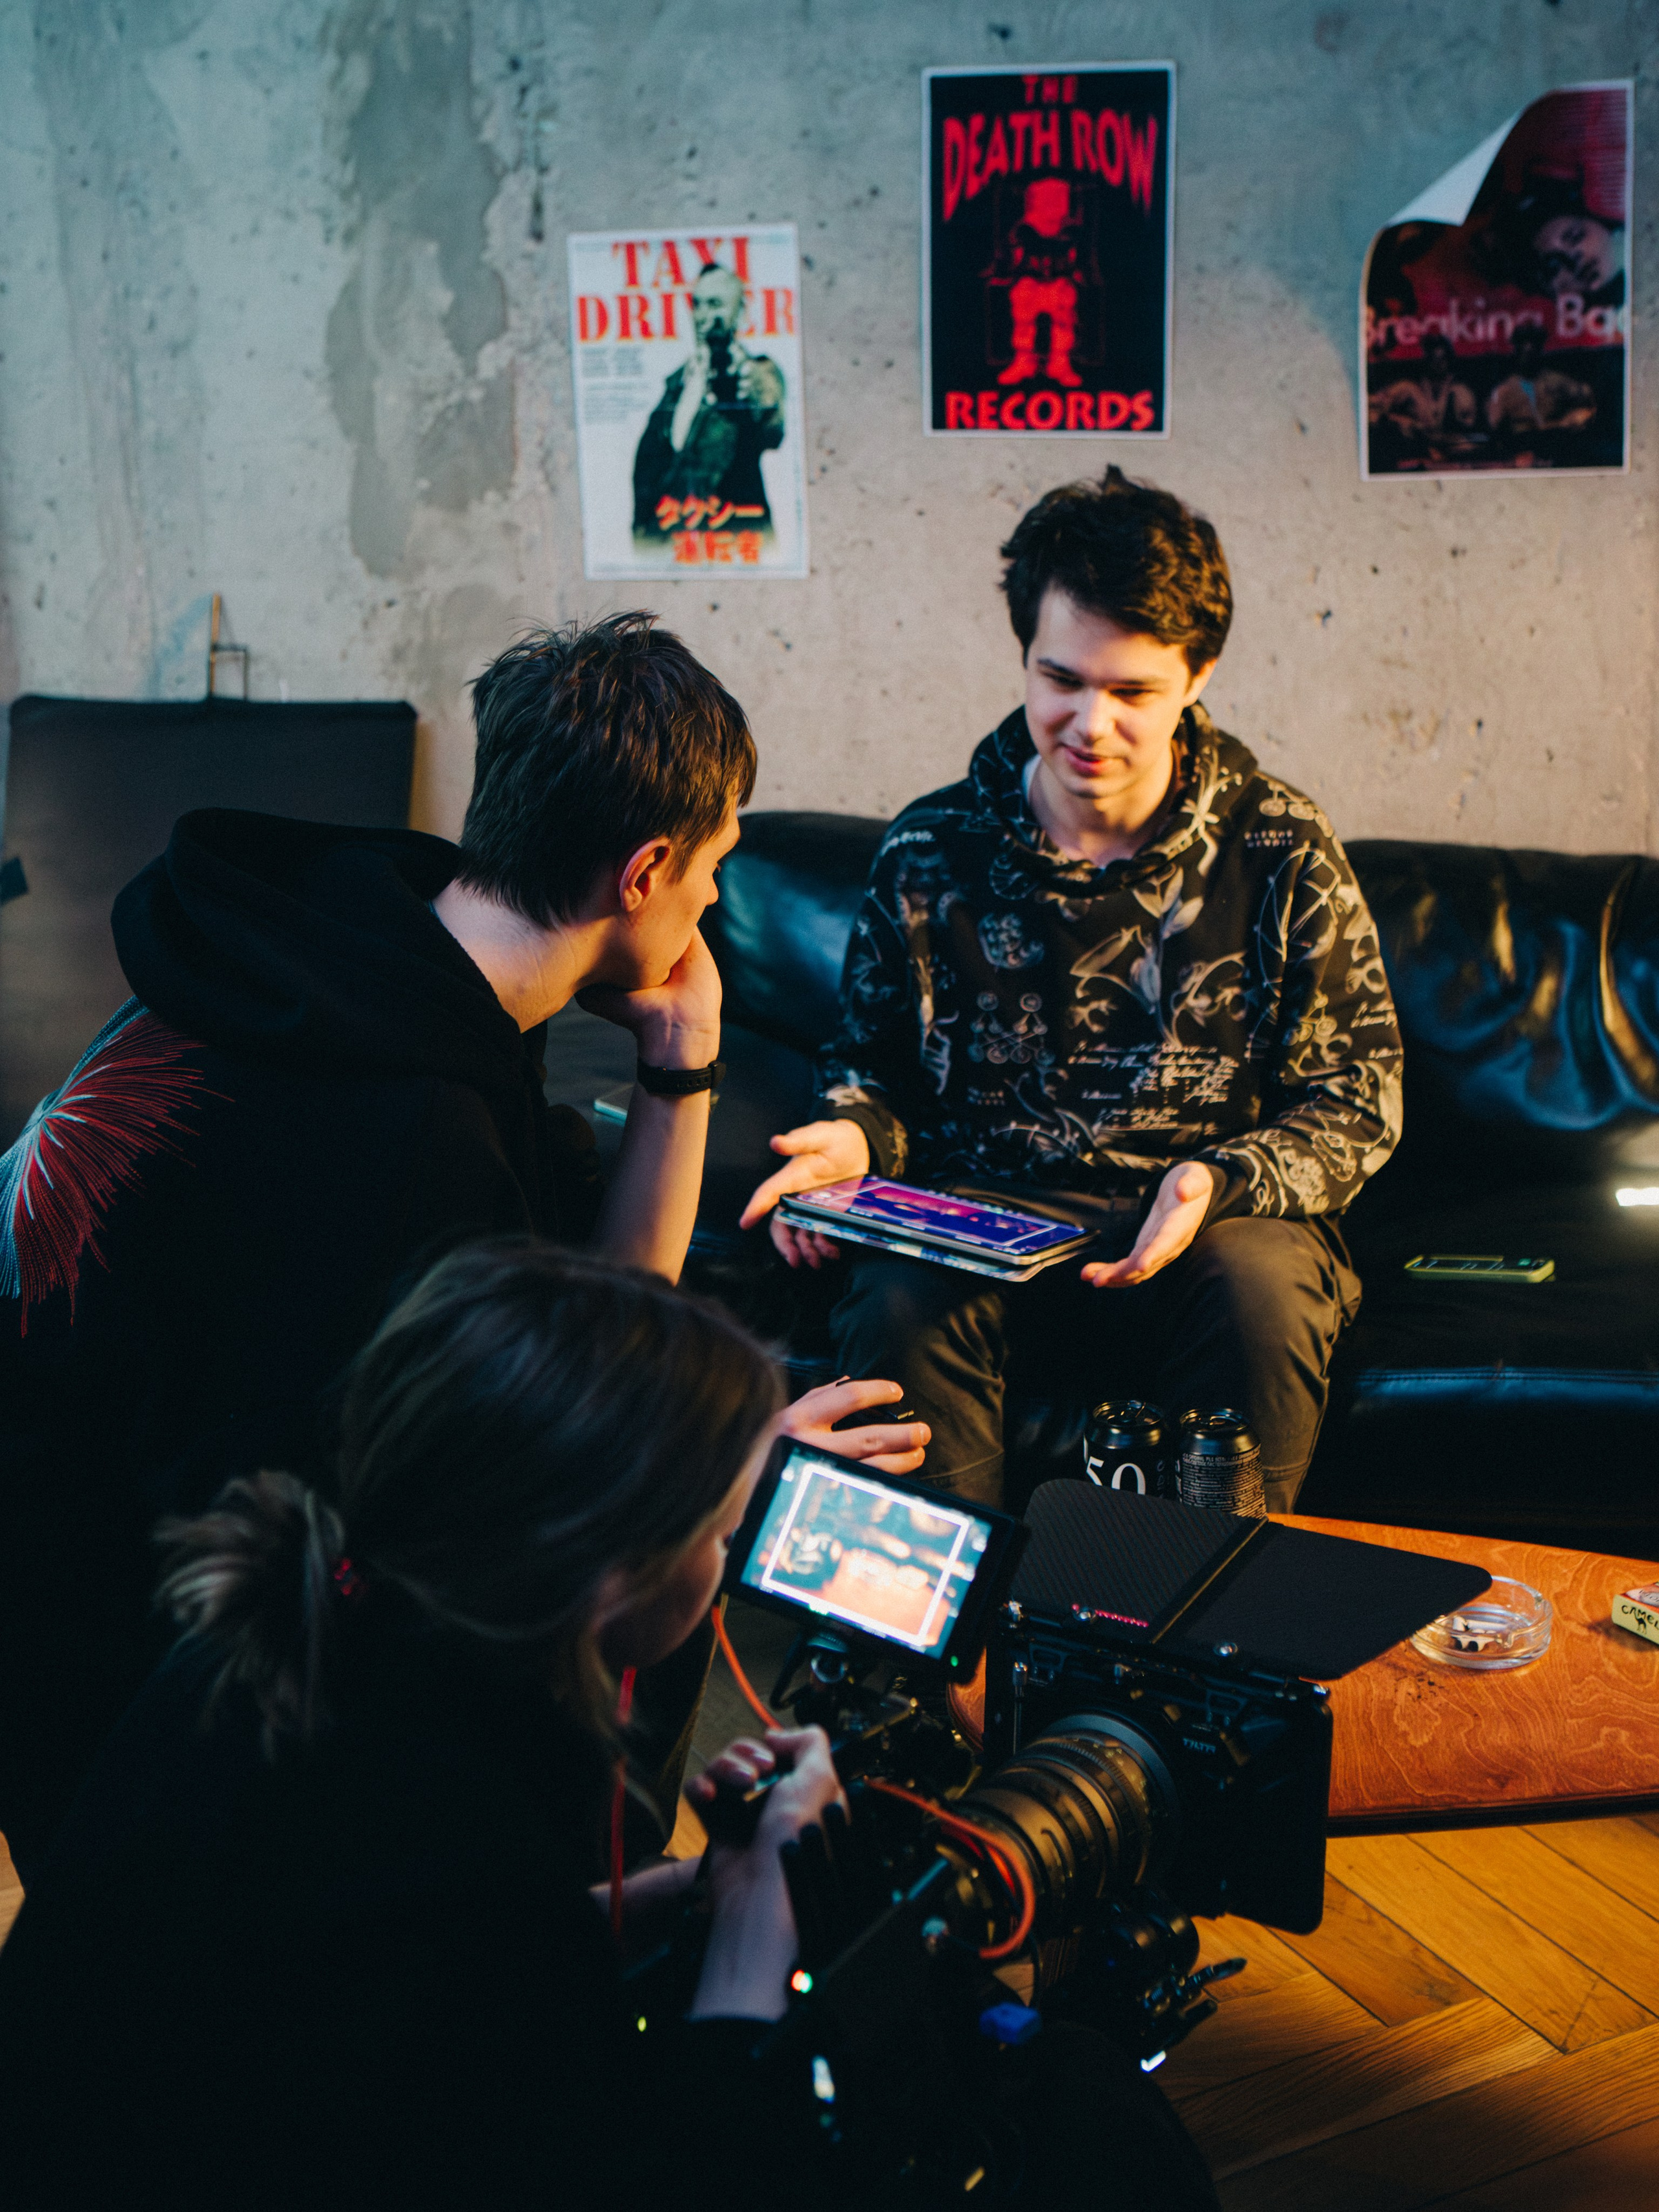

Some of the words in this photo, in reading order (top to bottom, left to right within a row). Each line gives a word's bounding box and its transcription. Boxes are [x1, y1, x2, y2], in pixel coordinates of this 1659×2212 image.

[1022, 75, 1078, 104] THE
[943, 111, 1060, 223] DEATH
[1070, 108, 1157, 216] ROW
[577, 288, 794, 343] DRIR
[945, 391, 1155, 431] RECORDS
[655, 494, 765, 531] タクシー
